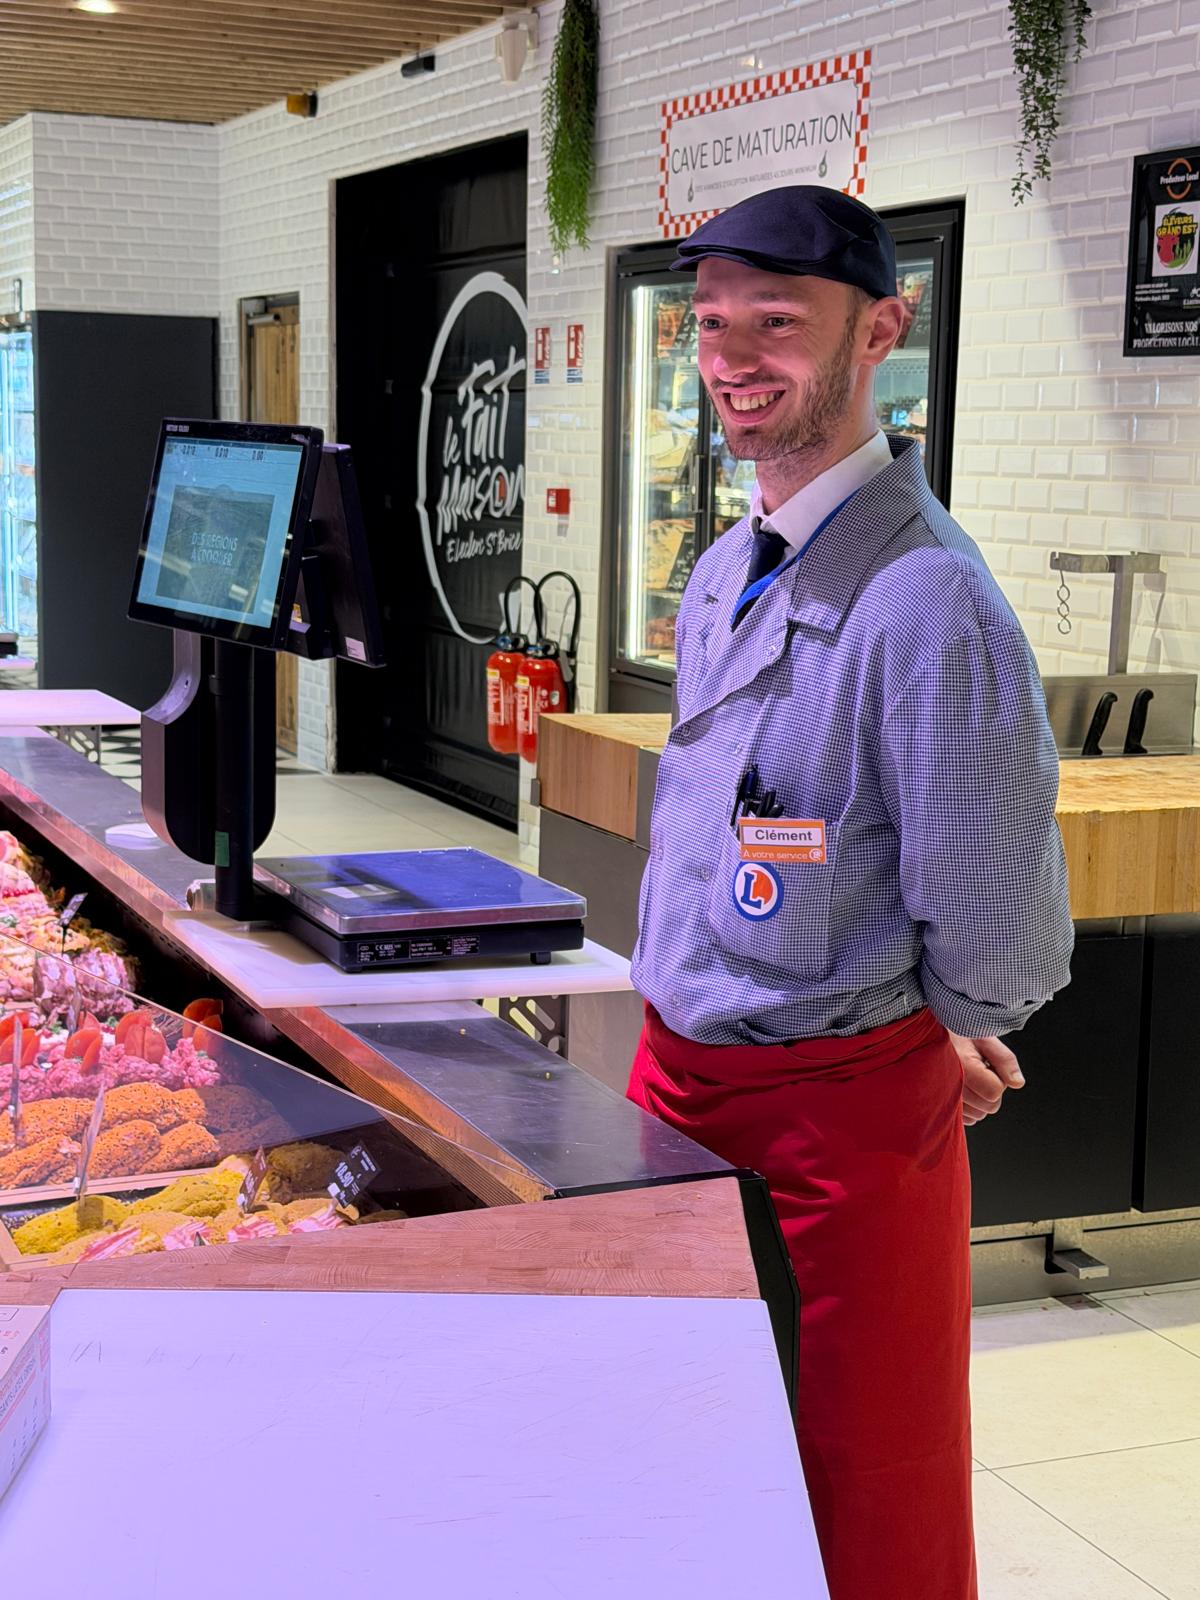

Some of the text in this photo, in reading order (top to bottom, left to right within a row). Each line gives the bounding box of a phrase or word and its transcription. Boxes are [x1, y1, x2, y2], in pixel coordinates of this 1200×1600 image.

[671, 111, 854, 174] CAVE DE MATURATION
[1160, 171, 1200, 185] Producteur Local
[1157, 225, 1198, 238] GRAND EST
[1184, 321, 1199, 333] NOS
[458, 346, 526, 466] Fait
[443, 416, 461, 467] le
[755, 828, 813, 841] Clément
[752, 851, 775, 859] votre
[776, 851, 808, 860] service
